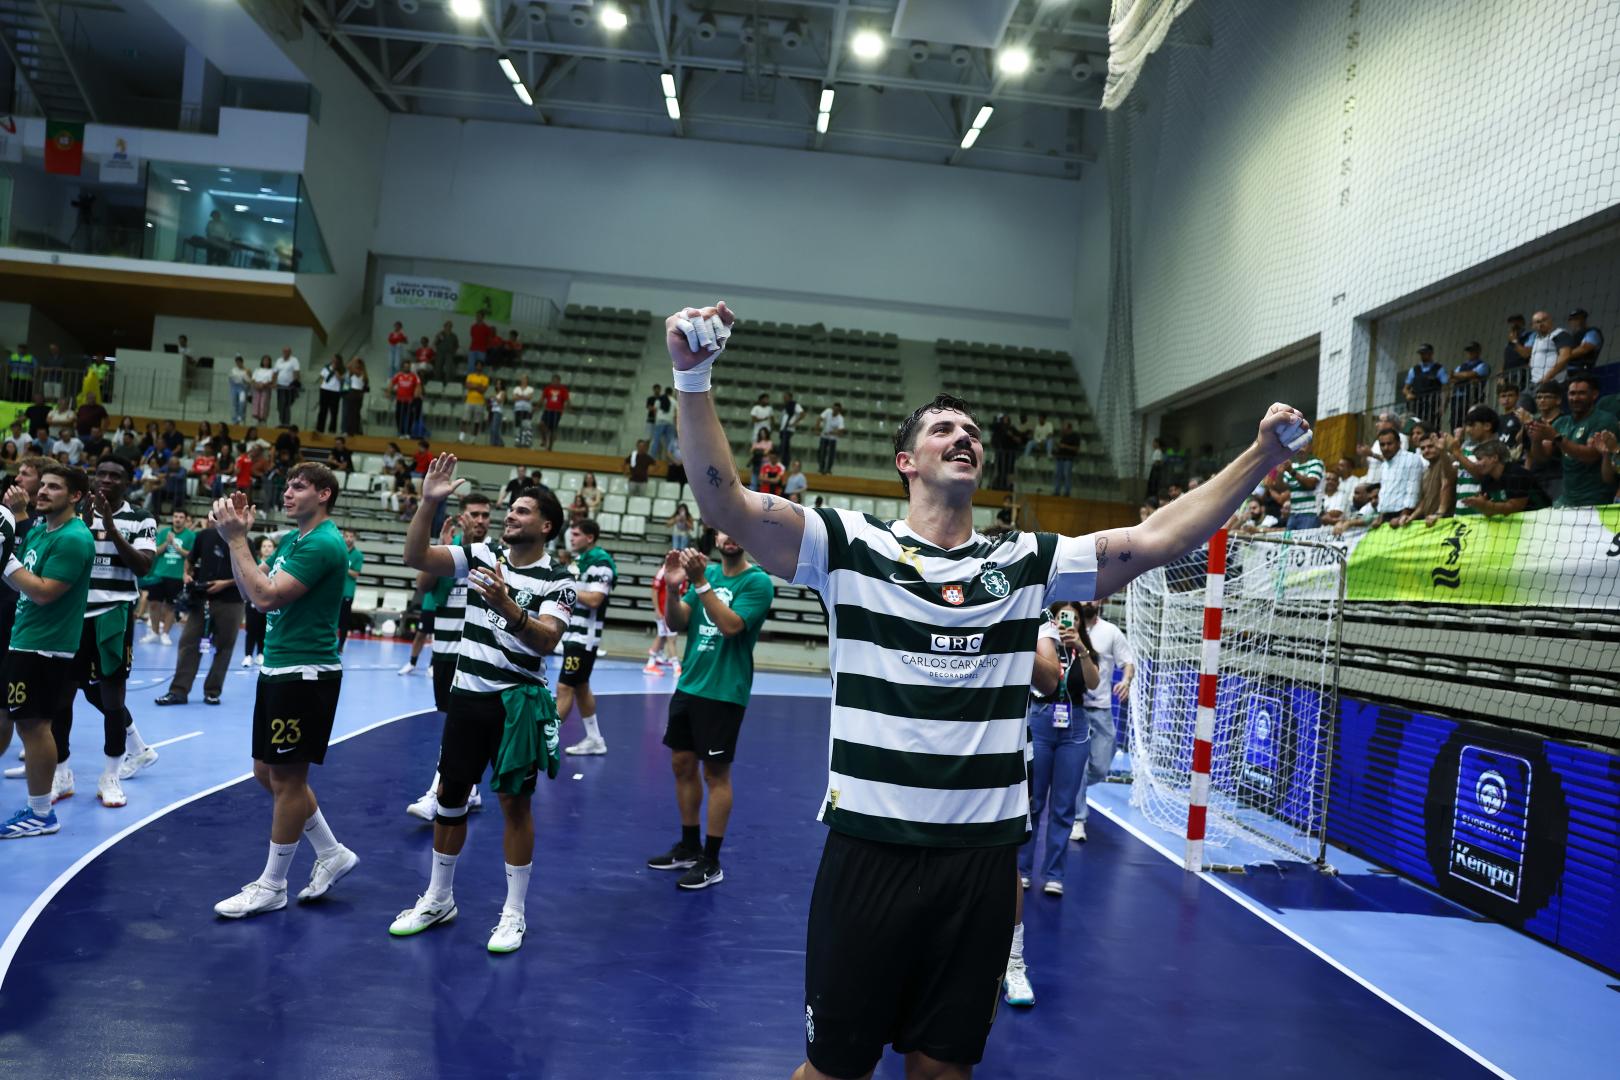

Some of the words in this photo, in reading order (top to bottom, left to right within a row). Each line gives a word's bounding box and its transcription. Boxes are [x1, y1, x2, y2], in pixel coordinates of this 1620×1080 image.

[390, 286, 424, 297] SANTO
[428, 289, 458, 301] TIRSO
[1265, 548, 1306, 569] SATO
[934, 635, 981, 650] CRC
[564, 655, 580, 671] 93
[901, 654, 947, 669] CARLOS
[949, 657, 999, 670] CARVALHO
[7, 682, 27, 704] 26
[271, 718, 301, 744] 23
[1455, 843, 1515, 887] Kempa
